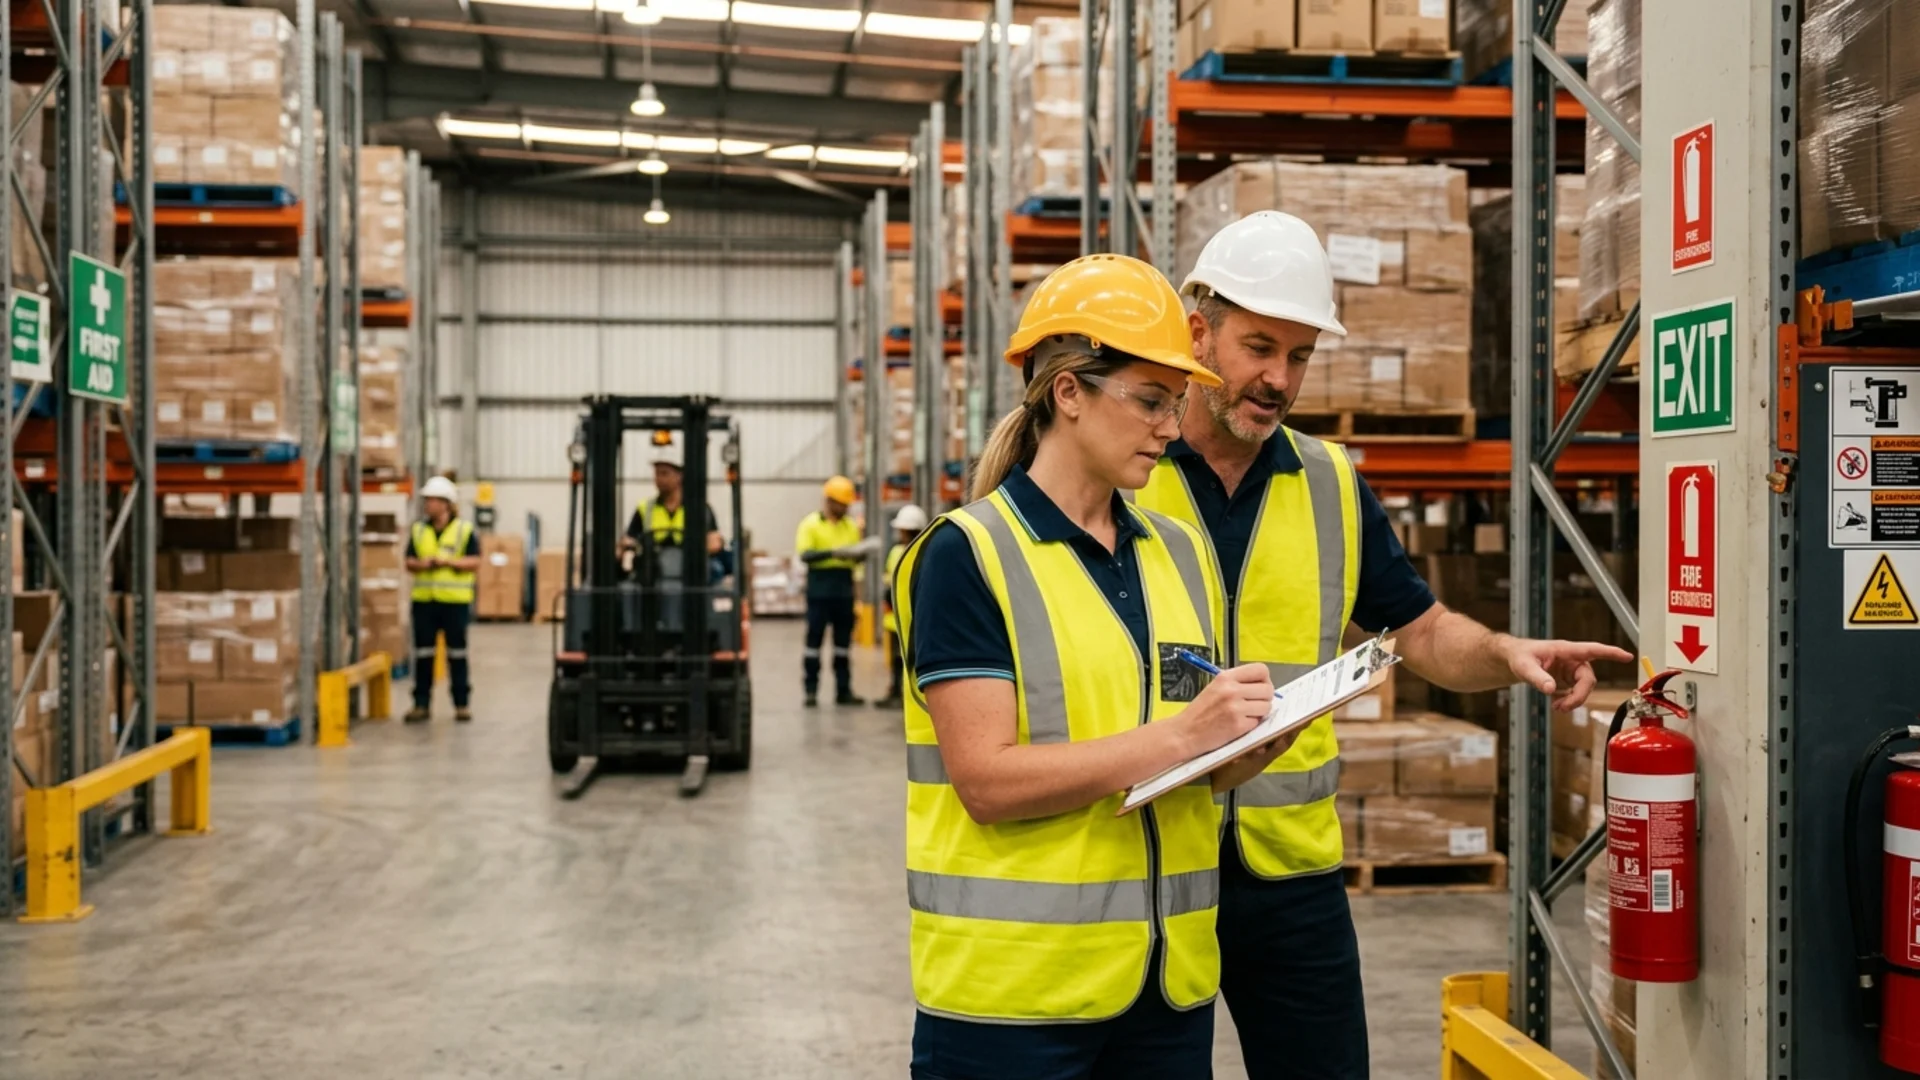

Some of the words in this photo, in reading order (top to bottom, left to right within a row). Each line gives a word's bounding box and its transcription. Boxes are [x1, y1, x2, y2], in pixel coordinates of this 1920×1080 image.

[80, 327, 120, 364] FIRST
[87, 362, 114, 393] AID
[1659, 319, 1727, 418] EXIT
